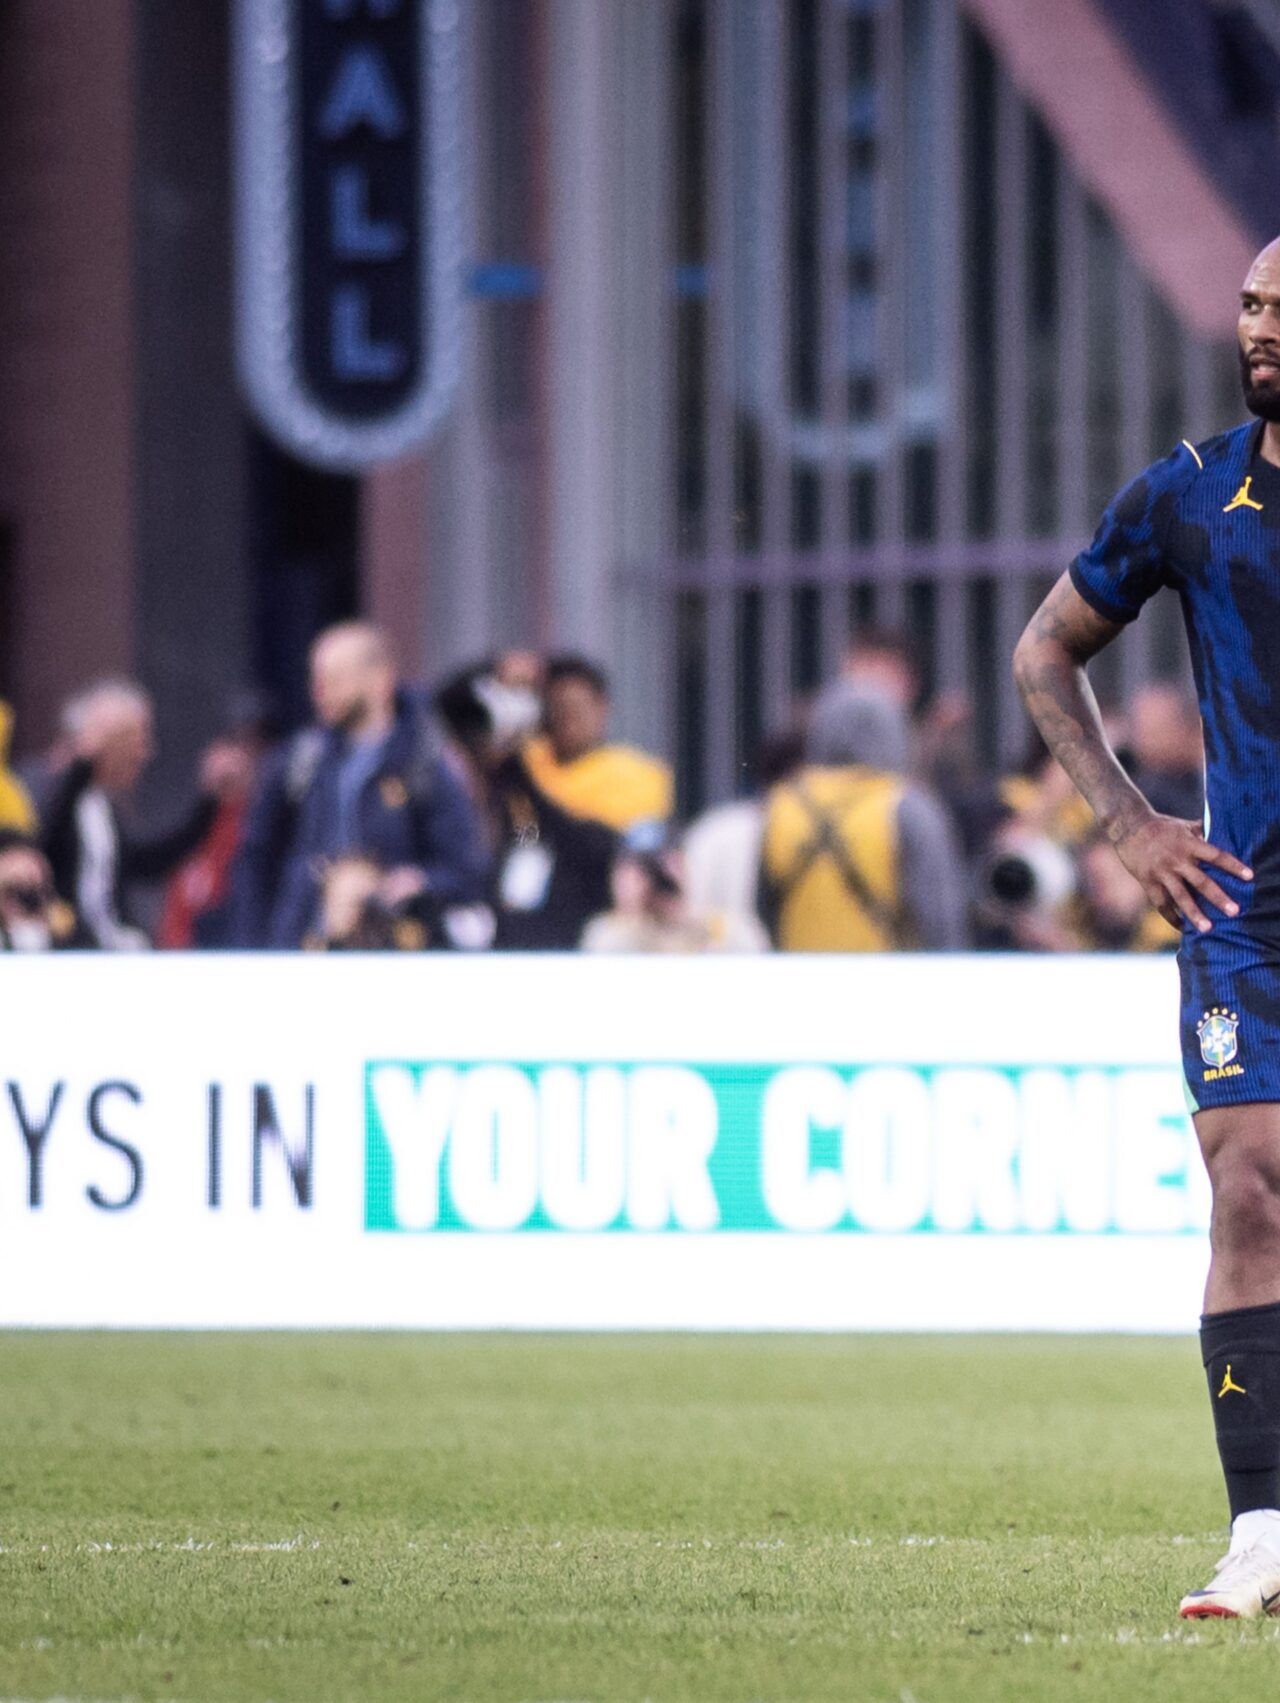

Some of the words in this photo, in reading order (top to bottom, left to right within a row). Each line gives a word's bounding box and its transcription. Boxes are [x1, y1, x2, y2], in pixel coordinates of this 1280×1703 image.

[318, 0, 402, 382] ALL
[6, 1079, 146, 1213] YS
[207, 1081, 315, 1212] IN
[368, 1063, 723, 1234] YOUR
[762, 1066, 1205, 1234] CORNE
[1203, 1064, 1245, 1082] BRASIL
